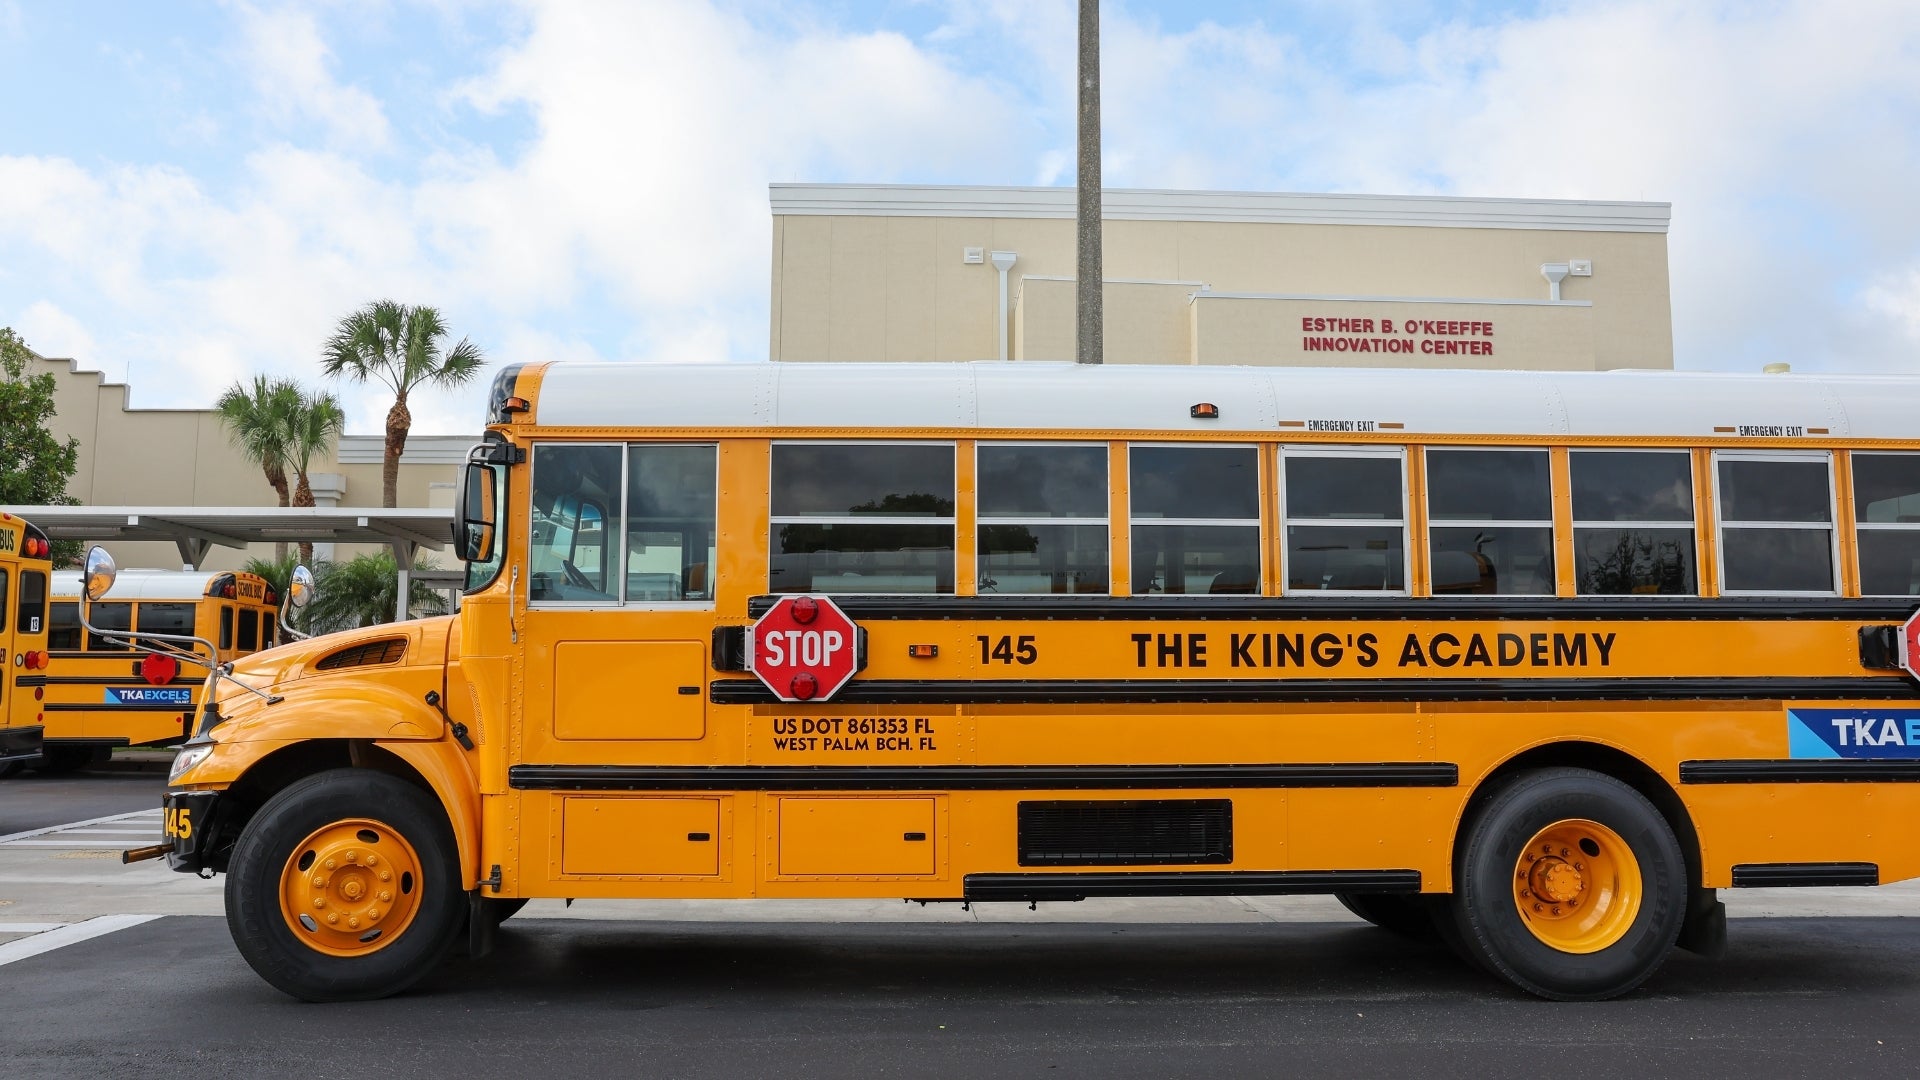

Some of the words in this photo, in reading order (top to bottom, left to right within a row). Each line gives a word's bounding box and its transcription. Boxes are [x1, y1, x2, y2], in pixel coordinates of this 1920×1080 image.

[1302, 318, 1374, 333] ESTHER
[1381, 319, 1398, 334] B.
[1405, 320, 1493, 336] O'KEEFFE
[1303, 337, 1414, 353] INNOVATION
[1421, 340, 1493, 355] CENTER
[1308, 420, 1354, 431] EMERGENCY
[1357, 421, 1375, 432] EXIT
[1739, 425, 1783, 437] EMERGENCY
[1786, 426, 1803, 437] EXIT
[238, 581, 253, 598] SCHOOL
[254, 584, 262, 599] BUS
[765, 630, 843, 667] STOP
[977, 635, 1038, 665] 145
[1131, 634, 1207, 667] THE
[1231, 633, 1379, 667] KING'S
[1398, 633, 1617, 667] ACADEMY
[120, 690, 190, 700] TKAEXCELS
[774, 718, 797, 734] US
[802, 718, 843, 734] DOT
[848, 718, 908, 734] 861353
[914, 719, 934, 734] FL
[774, 738, 817, 751] WEST
[823, 738, 869, 750] PALM
[876, 738, 913, 751] BCH.
[919, 738, 936, 750] FL
[164, 807, 192, 839] 145
